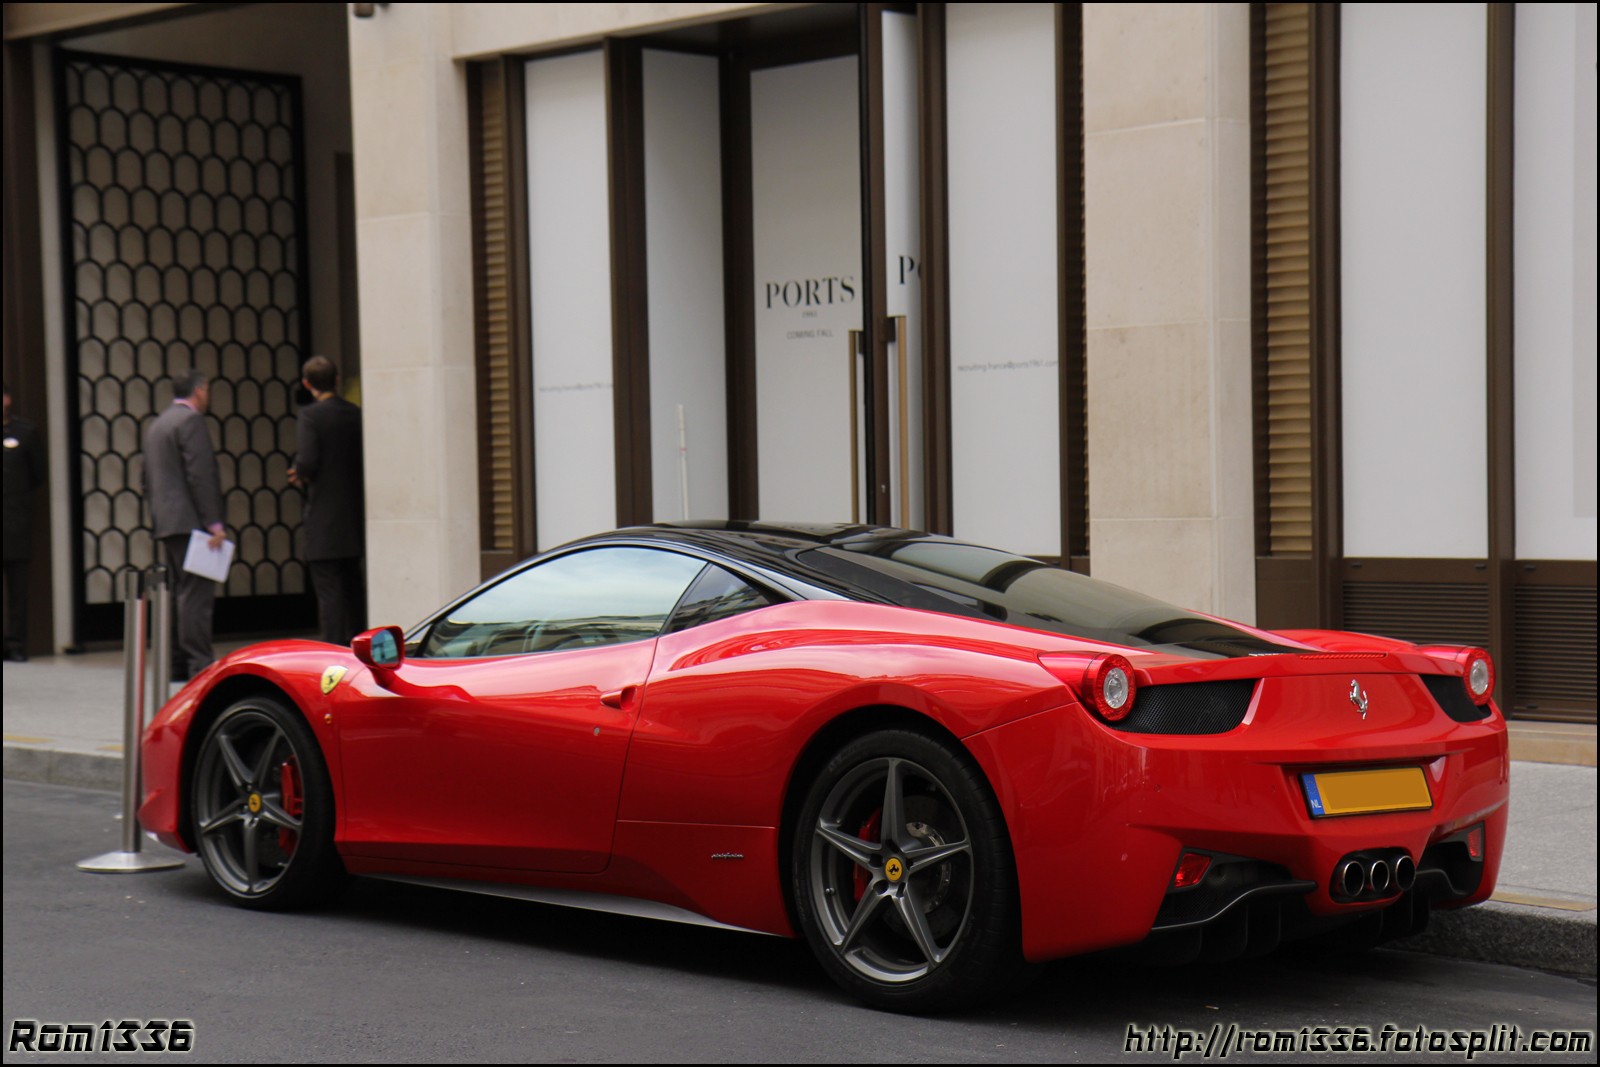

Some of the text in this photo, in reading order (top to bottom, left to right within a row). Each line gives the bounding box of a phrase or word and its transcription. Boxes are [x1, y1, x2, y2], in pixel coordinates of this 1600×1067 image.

[898, 255, 923, 285] P
[765, 275, 856, 309] PORTS
[786, 329, 833, 340] COMING FALL
[1310, 799, 1322, 809] NL
